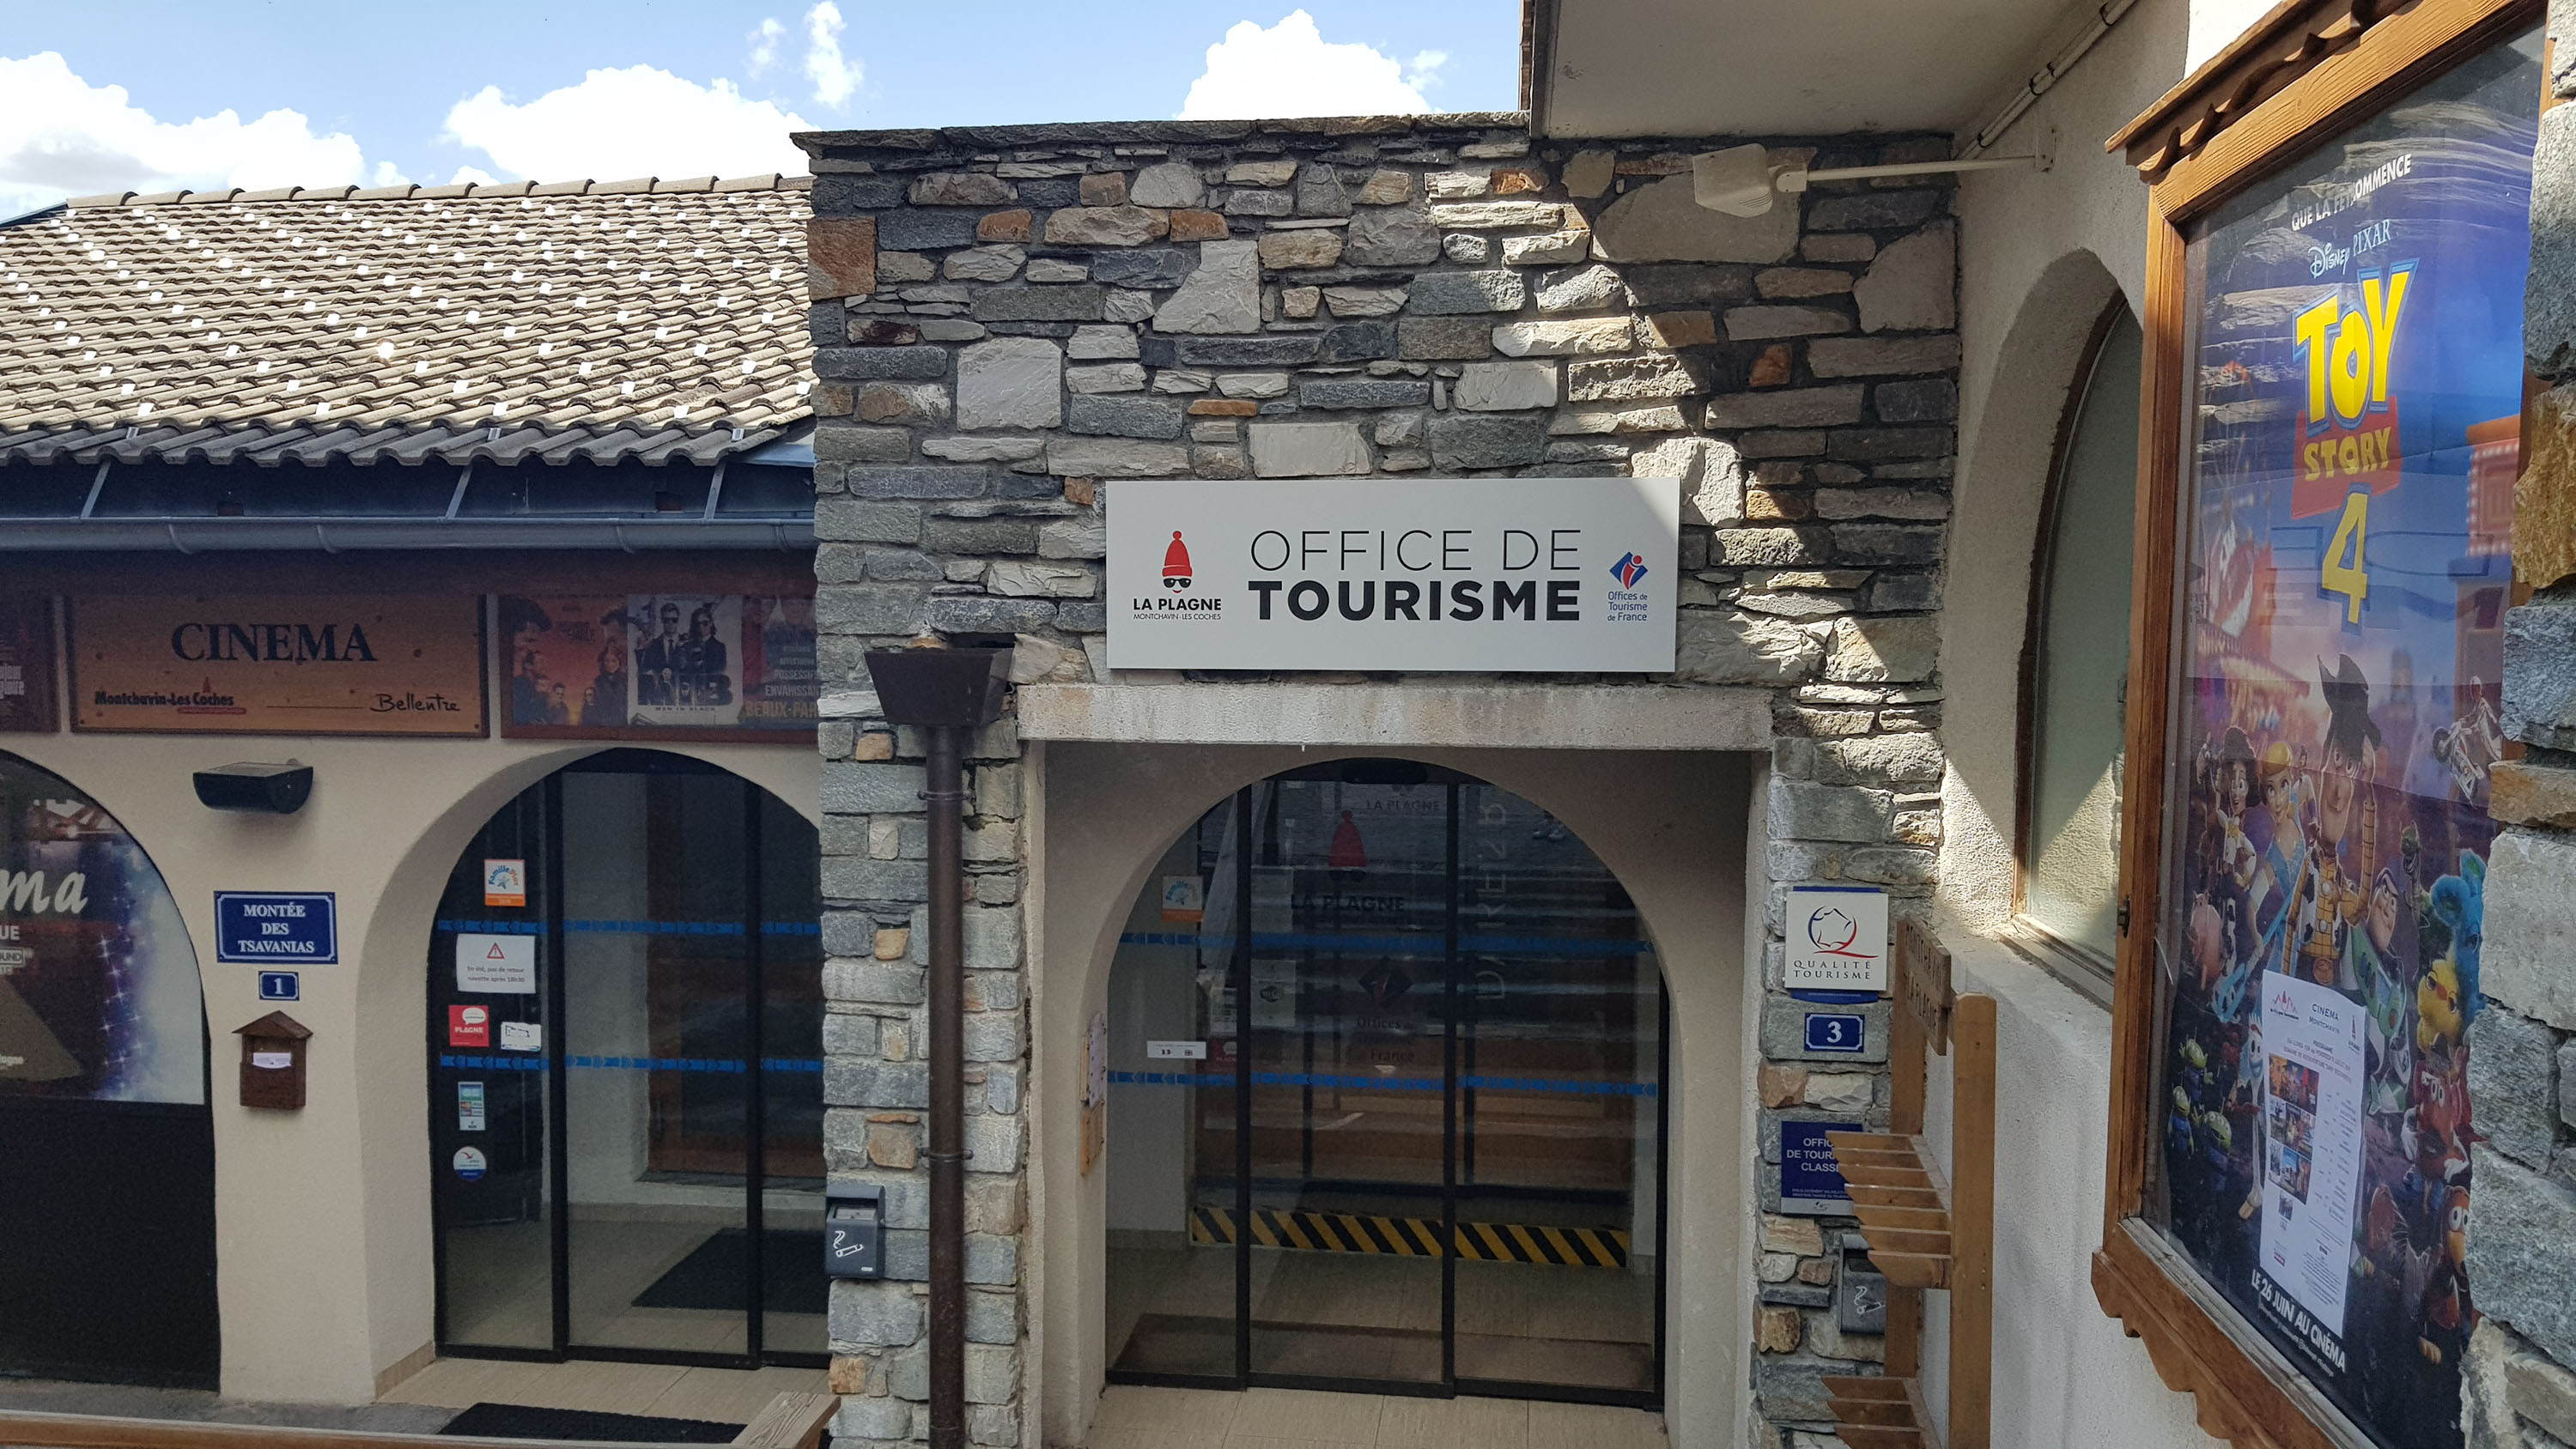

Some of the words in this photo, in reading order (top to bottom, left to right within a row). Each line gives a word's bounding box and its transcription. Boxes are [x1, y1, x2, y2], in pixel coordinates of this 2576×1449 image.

[2291, 206, 2313, 232] QUE
[2316, 199, 2331, 221] LA
[2353, 219, 2391, 258] PIXAR
[2293, 262, 2416, 434] TOY
[2303, 426, 2392, 482] STORY
[1250, 530, 1472, 572] OFFICE
[1503, 530, 1581, 571] DE
[2320, 489, 2371, 627] 4
[1133, 598, 1153, 610] LA
[1158, 598, 1222, 611] PLAGNE
[1248, 579, 1581, 621] TOURISME
[1607, 591, 1637, 601] Offices
[1639, 592, 1648, 601] de
[1608, 601, 1648, 611] Tourisme
[1607, 613, 1616, 621] de
[1618, 612, 1648, 621] France
[172, 622, 378, 664] CINEMA
[192, 691, 234, 706] Coches
[369, 693, 461, 713] Bellentre
[244, 901, 306, 918] MONTÉE
[261, 922, 290, 935] DES
[238, 940, 315, 954] TSAVANIAS
[1793, 960, 1871, 970] QUALITÉ
[1793, 970, 1871, 979] TOURISME
[274, 977, 284, 995] 1
[2312, 1003, 2340, 1022] CINEMA
[1826, 1021, 1843, 1044] 3
[1802, 1137, 1835, 1148] OFFIC
[1786, 1149, 1801, 1159] DE
[2251, 1269, 2261, 1291] LE
[2260, 1278, 2273, 1301] 26
[2272, 1290, 2295, 1323] JUIN
[2294, 1311, 2311, 1335] AU
[2310, 1324, 2346, 1373] CINÉMA
